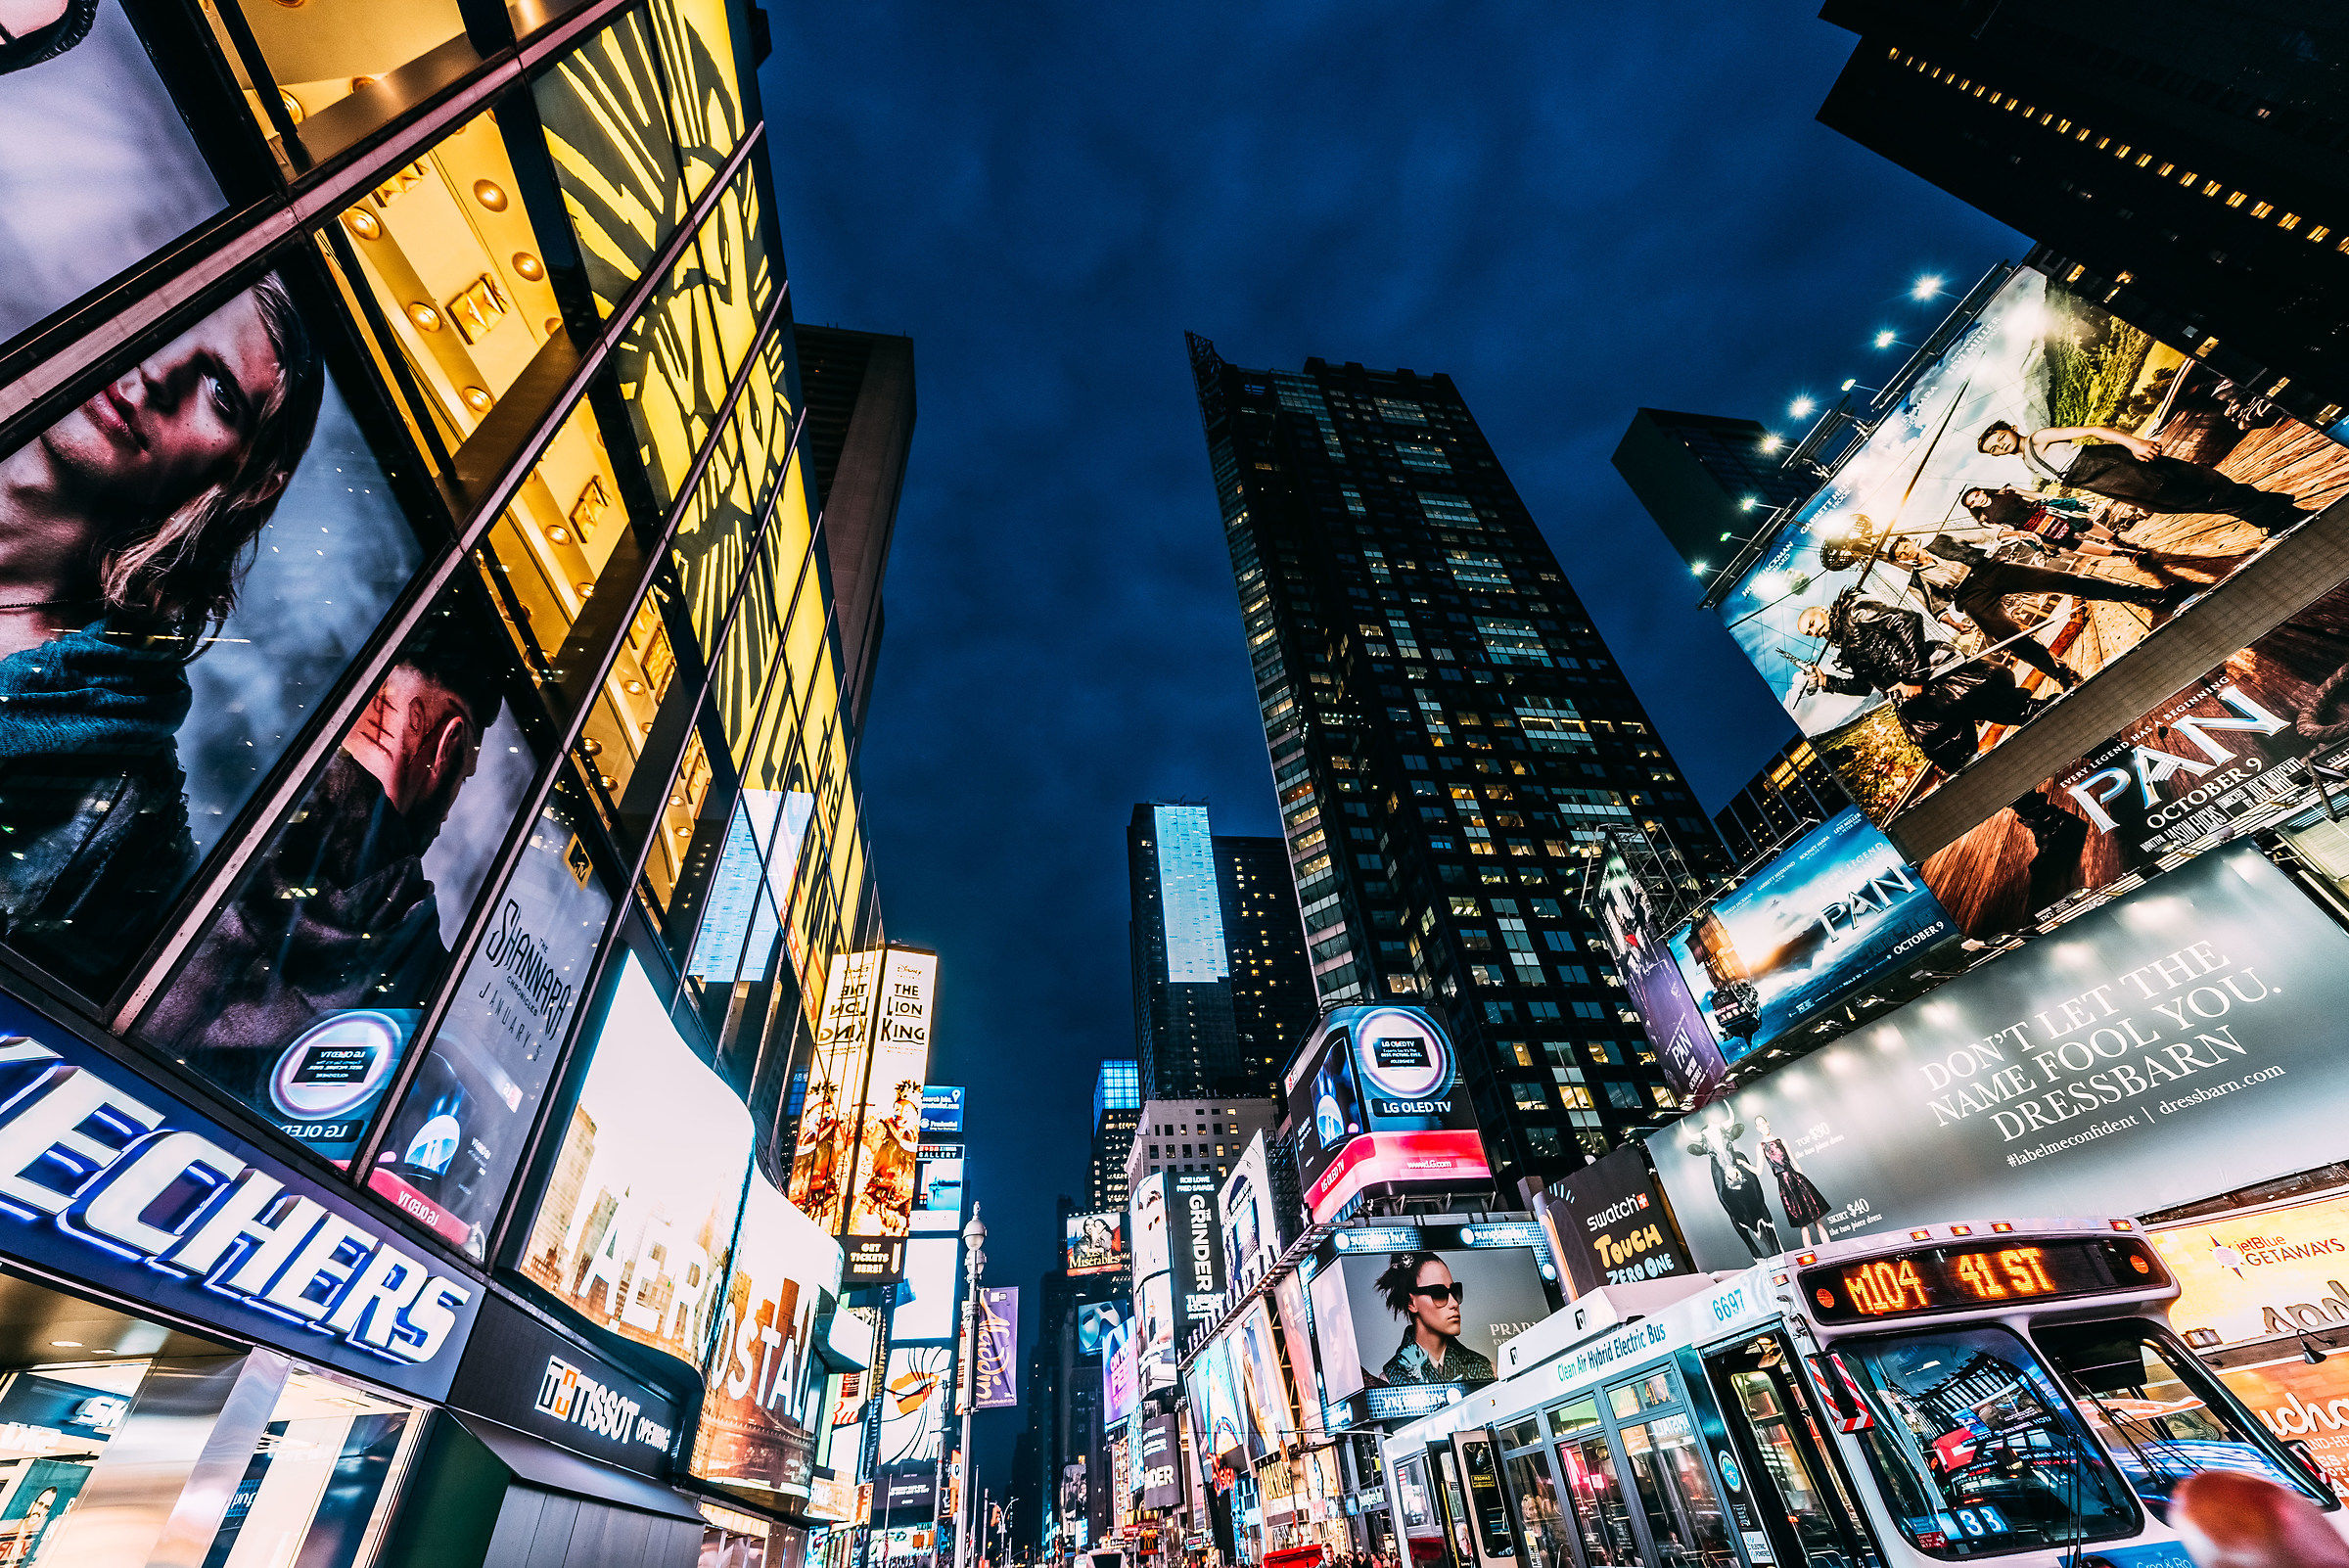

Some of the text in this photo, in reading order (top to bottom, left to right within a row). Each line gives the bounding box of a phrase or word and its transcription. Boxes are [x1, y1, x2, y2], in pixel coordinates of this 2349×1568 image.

[1800, 497, 1833, 534] GARRETT
[2059, 768, 2088, 789] EVERY
[2091, 741, 2130, 769] LEGEND
[2131, 725, 2153, 744] HAS
[2164, 675, 2231, 722] BEGINNING
[2068, 685, 2291, 835] PAN
[2146, 757, 2263, 829] OCTOBER 9
[1847, 842, 1884, 869] LEGEND
[1819, 866, 1917, 943] PAN
[539, 938, 549, 953] THE
[1894, 926, 1939, 955] OCTOBER
[1935, 921, 1945, 931] 9
[485, 899, 571, 1040] SHANNARA
[507, 975, 538, 1017] CHRONICLES
[887, 996, 923, 1016] LION
[895, 984, 919, 996] THE
[479, 982, 531, 1048] JANUARY
[881, 1018, 925, 1041] KING
[1919, 940, 2231, 1091] DON'T LET THE
[1672, 1027, 1693, 1070] PAN
[1926, 966, 2282, 1128] NAME FOOL YOU.
[1989, 1024, 2247, 1142] DRESSBARN
[1382, 1100, 1451, 1114] LG OLED TV
[2006, 1062, 2286, 1168] #labelmeconfident dressbarn.com
[1587, 1193, 1638, 1233] swatch
[1827, 1211, 1848, 1224] SKIRT
[1829, 1227, 1839, 1236] the
[1839, 1223, 1851, 1233] two
[851, 1253, 889, 1263] TICKETS
[861, 1243, 881, 1252] GET
[1069, 1254, 1121, 1269] Misérables
[1189, 1194, 1213, 1292] GRINDER
[1593, 1223, 1664, 1268] TOUCH
[2236, 1233, 2286, 1256] jetBlue
[2246, 1237, 2346, 1268] GETAWAYS
[853, 1264, 883, 1273] HERE!
[1605, 1253, 1676, 1286] ZERO ONE
[1845, 1247, 2054, 1314] M104 41 ST
[1713, 1288, 1745, 1322] 6697
[976, 1287, 1011, 1400] Aladdin
[1490, 1321, 1538, 1337] PRAD
[1557, 1323, 1666, 1382] Clean Air Hybrid Electric Bus
[572, 1373, 671, 1453] TISSOT OPENING
